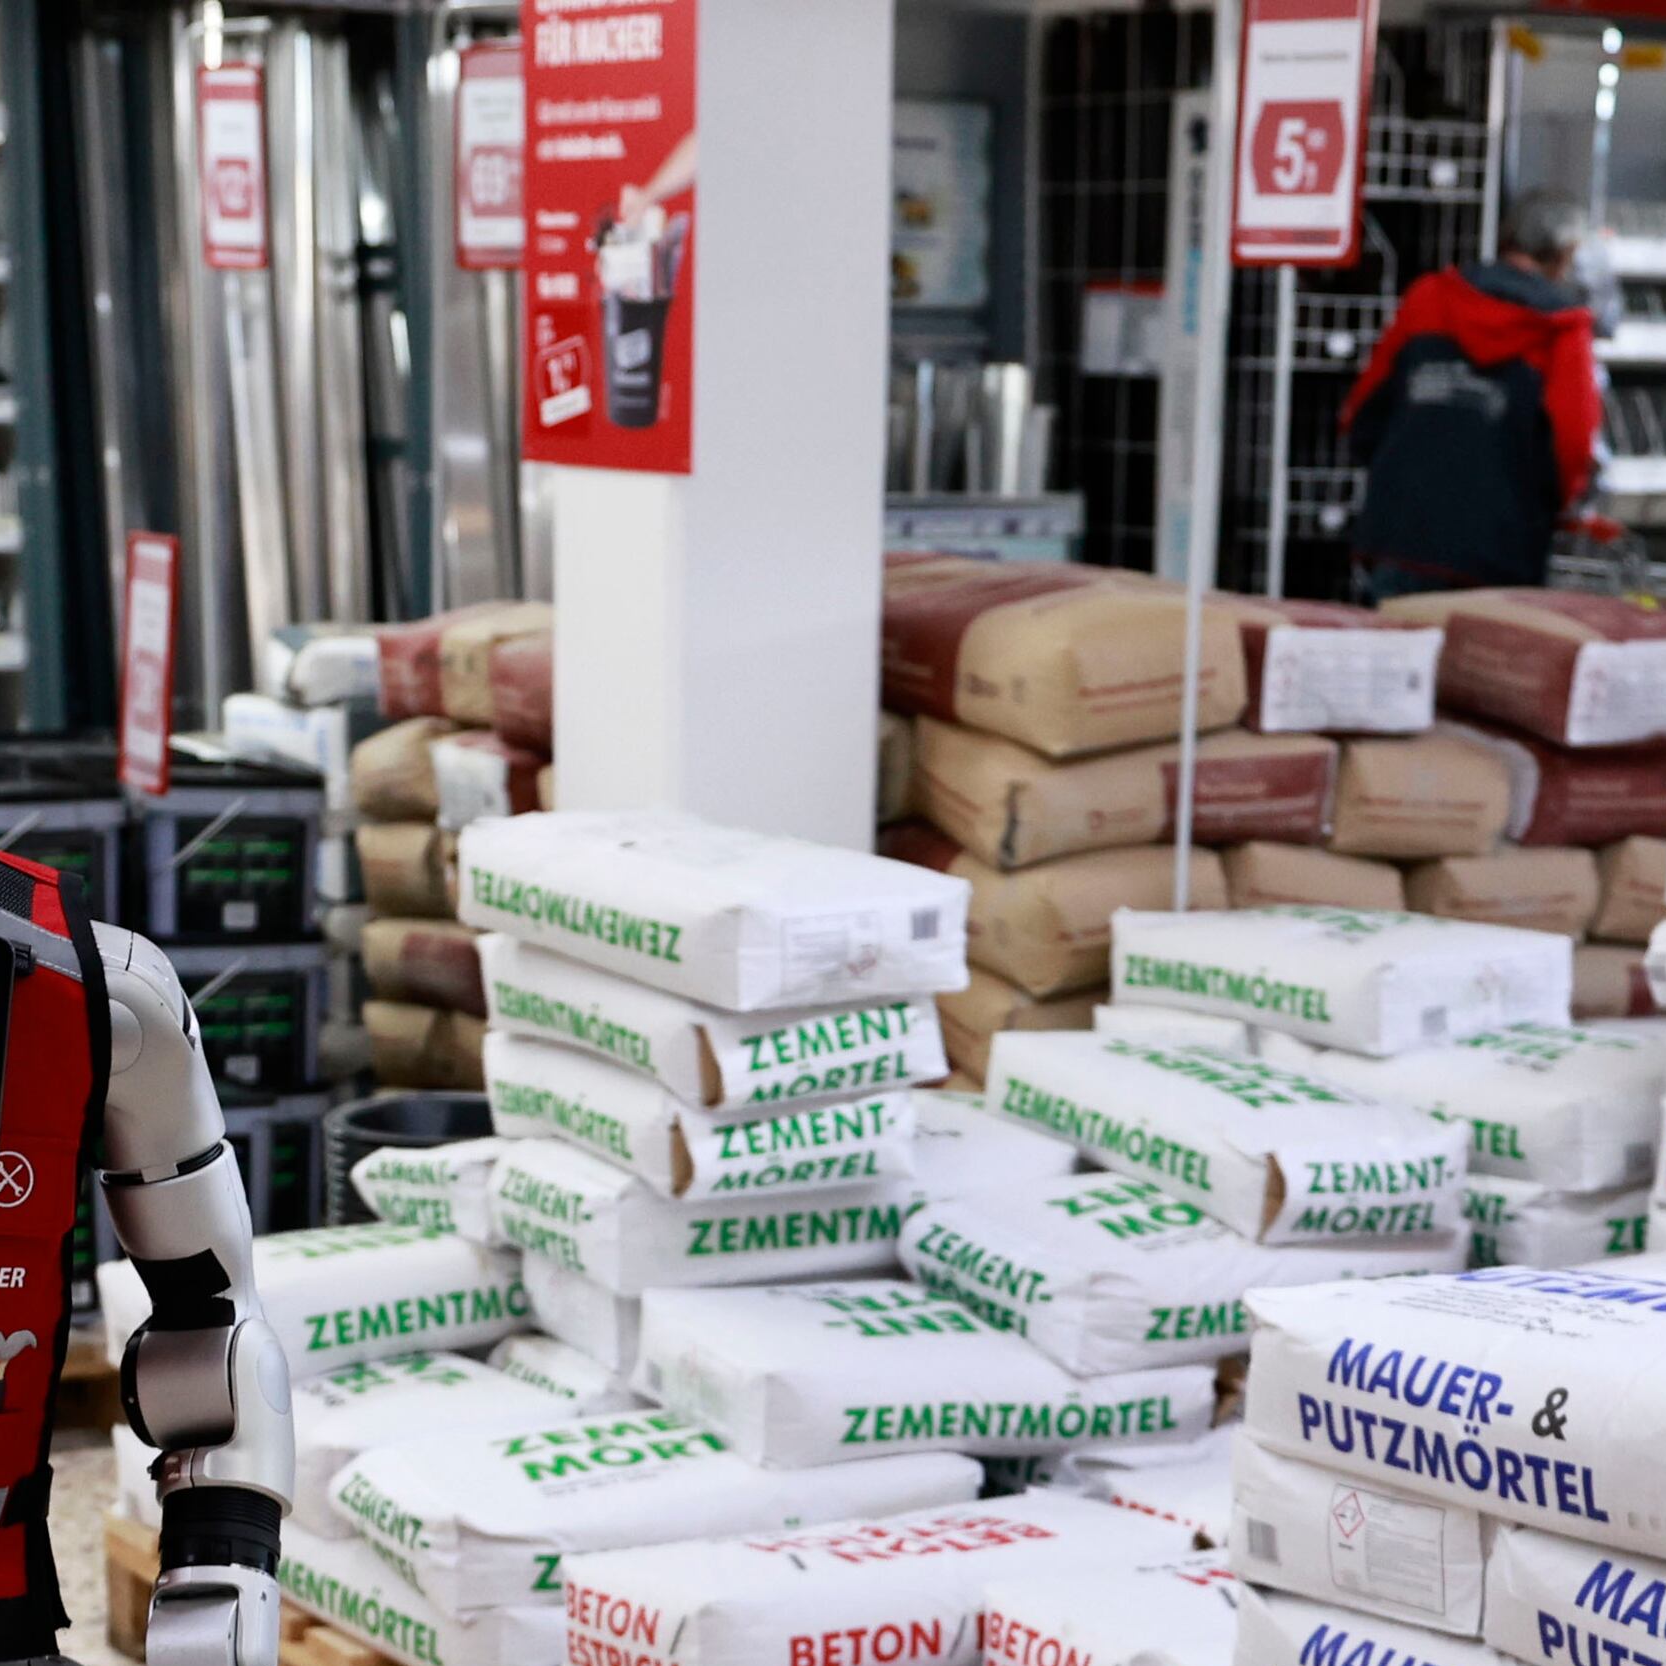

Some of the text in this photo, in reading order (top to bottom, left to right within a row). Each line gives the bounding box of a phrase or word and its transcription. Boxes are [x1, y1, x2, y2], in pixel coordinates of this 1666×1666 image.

[1123, 953, 1332, 1023] ZEMENTMÖRTEL
[711, 1102, 896, 1160] ZEMENT-
[1001, 1075, 1213, 1193] ZEMENTMÖRTEL
[498, 1166, 594, 1226] ZEMENT-
[709, 1149, 881, 1193] MÖRTEL
[1304, 1155, 1456, 1195] ZEMENT-
[686, 1192, 927, 1258] ZEMENTM
[1291, 1197, 1437, 1234] MÖRTEL
[916, 1223, 1054, 1305] ZEMENT-
[840, 1391, 1178, 1444] ZEMENTMÖRTEL
[1327, 1336, 1569, 1442] MAUER- &
[1297, 1391, 1610, 1524] PUTZMÖRTEL
[336, 1472, 432, 1550] ZEMENT-
[566, 1581, 660, 1647] BETON
